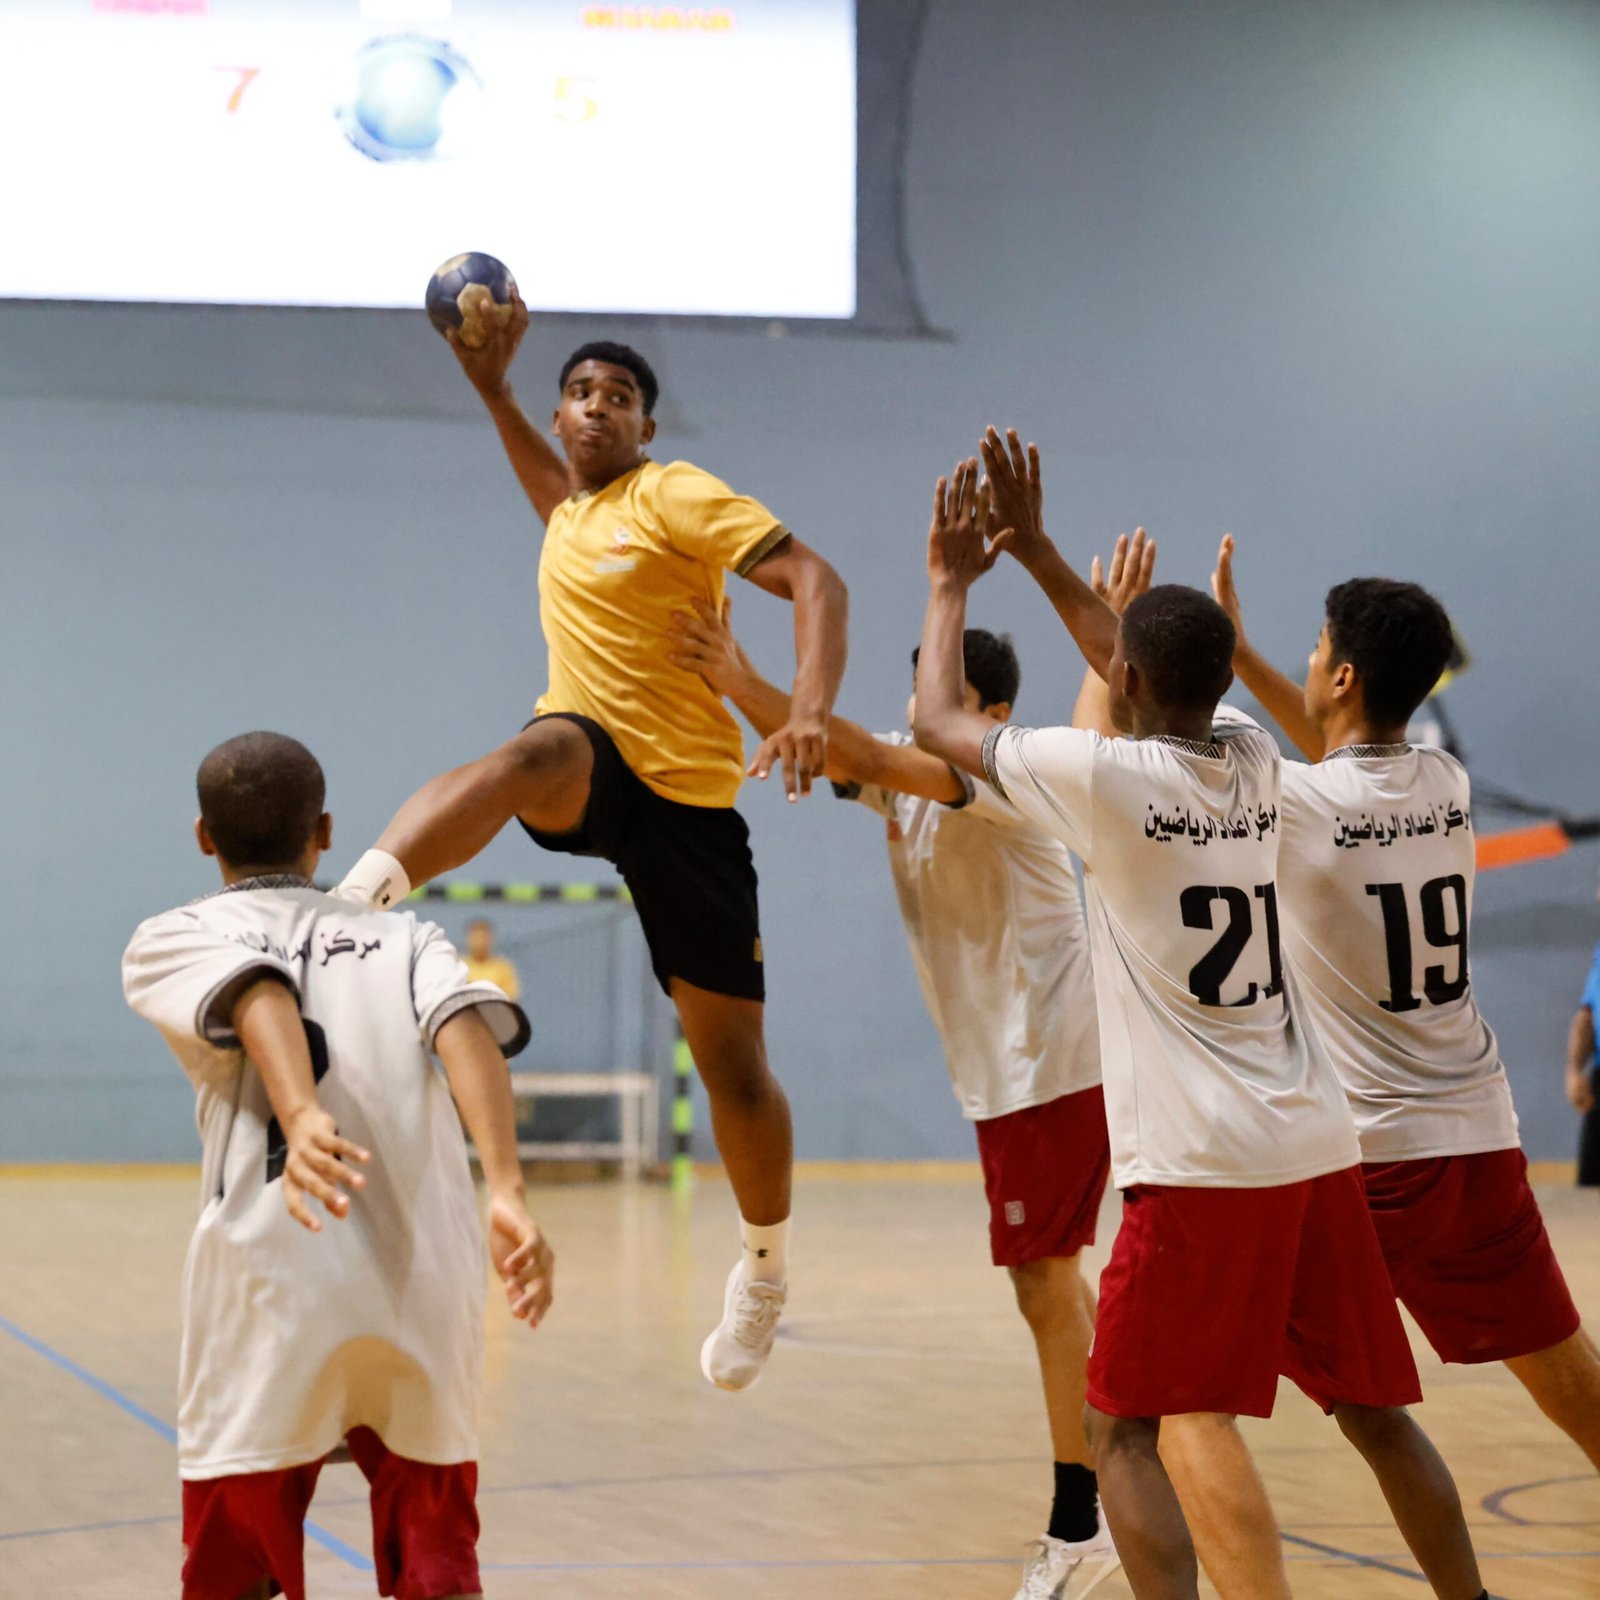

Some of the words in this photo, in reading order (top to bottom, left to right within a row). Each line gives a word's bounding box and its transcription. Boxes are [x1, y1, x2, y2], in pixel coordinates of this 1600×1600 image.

[211, 65, 260, 113] 7
[553, 77, 598, 124] 5
[1144, 803, 1217, 846] الرياضيين
[1334, 812, 1402, 848] الرياضيين
[318, 929, 381, 967] مركز
[1179, 880, 1284, 1007] 21
[1365, 873, 1470, 1012] 19
